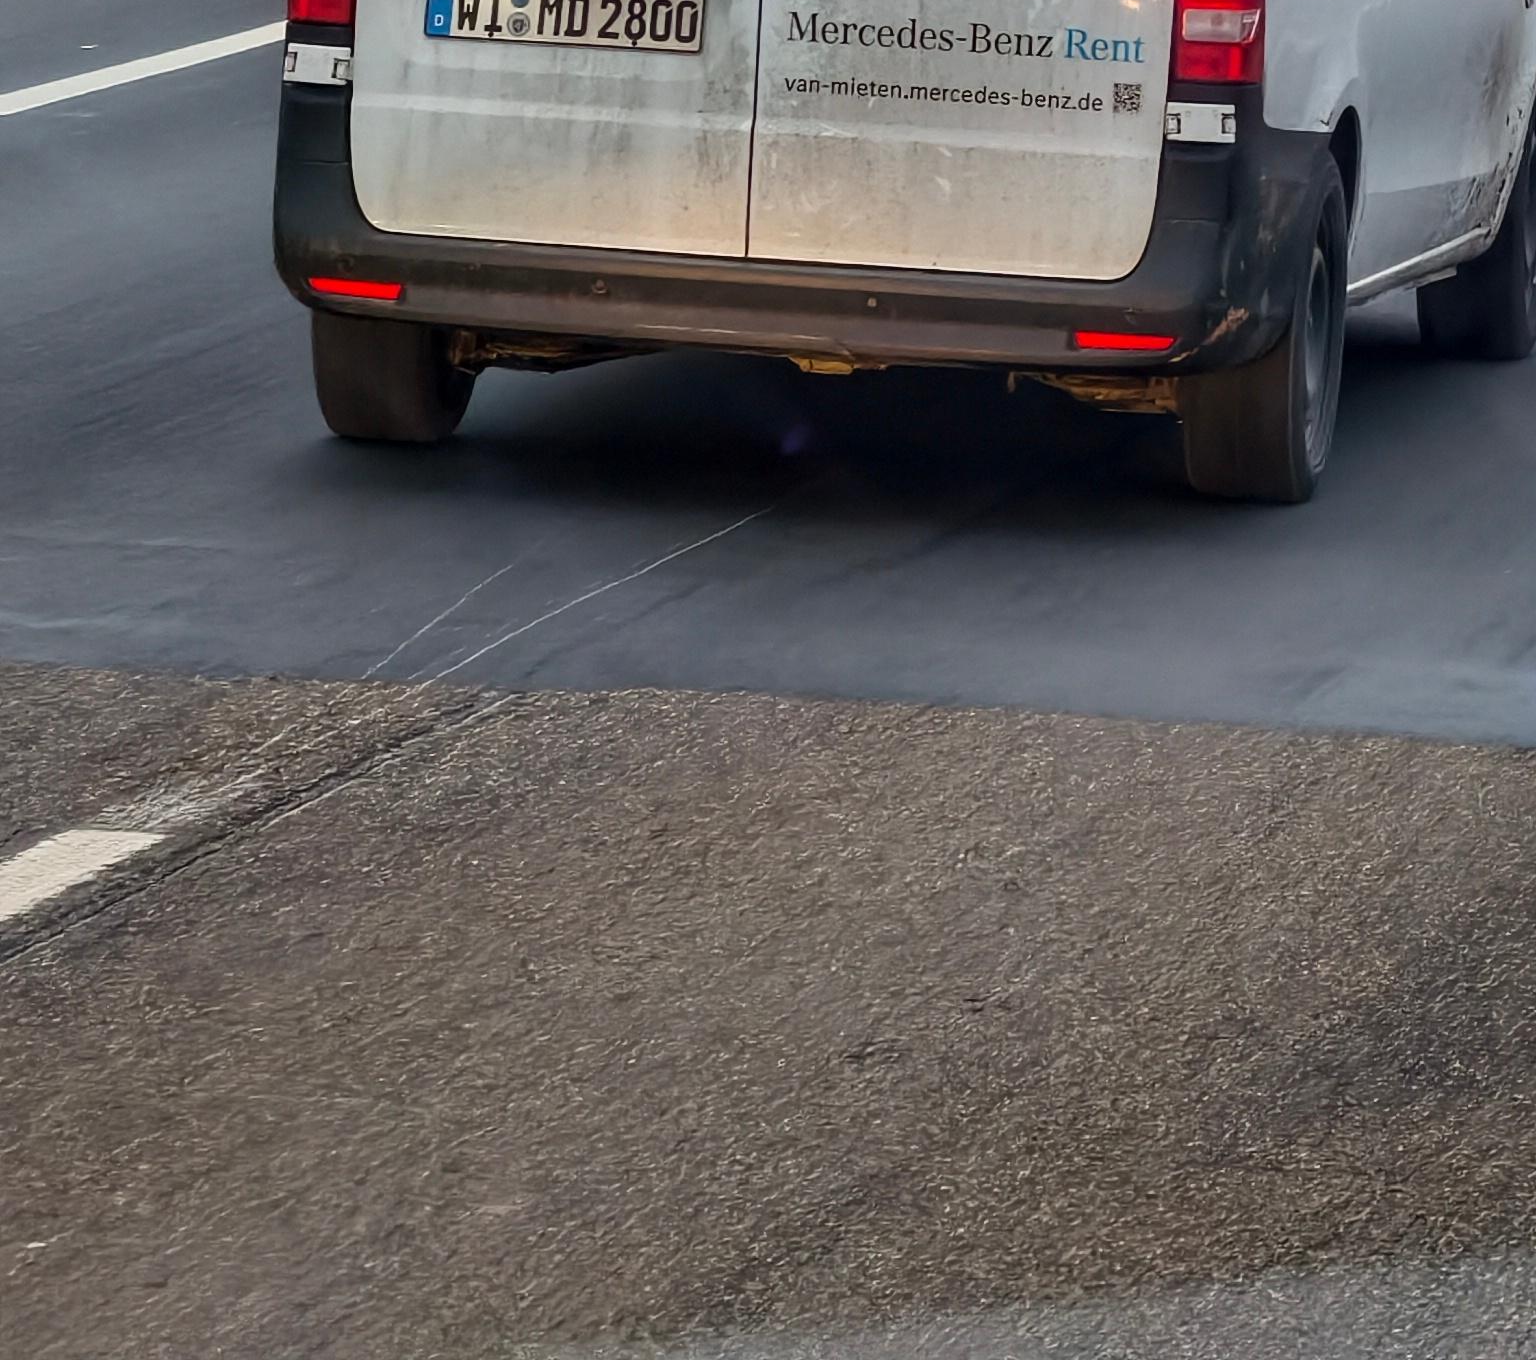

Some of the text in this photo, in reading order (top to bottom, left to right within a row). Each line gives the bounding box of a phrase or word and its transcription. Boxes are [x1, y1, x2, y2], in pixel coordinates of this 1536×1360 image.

[787, 11, 1145, 64] Mercedes-Benz Rent
[785, 77, 1103, 112] van-mieten.mercedes-benz.de
